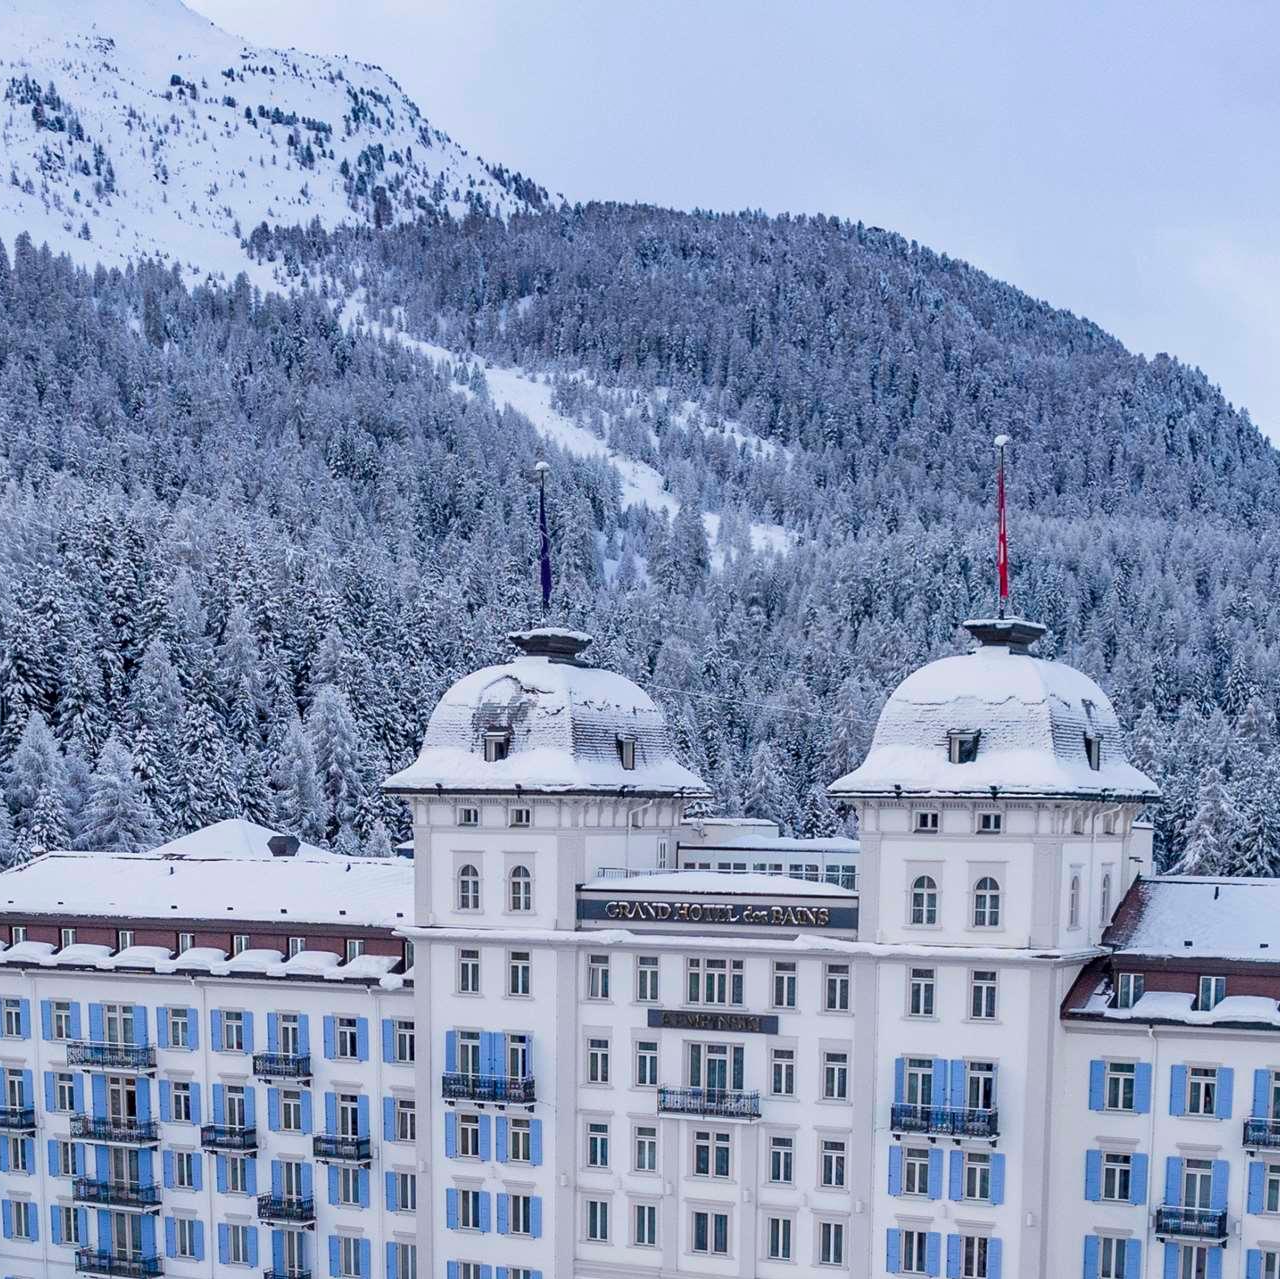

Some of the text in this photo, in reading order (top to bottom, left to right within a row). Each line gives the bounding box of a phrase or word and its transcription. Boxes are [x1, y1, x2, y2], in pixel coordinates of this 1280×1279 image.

[604, 901, 671, 919] GRAND
[674, 903, 739, 921] HOTEL
[771, 906, 829, 925] BAINS
